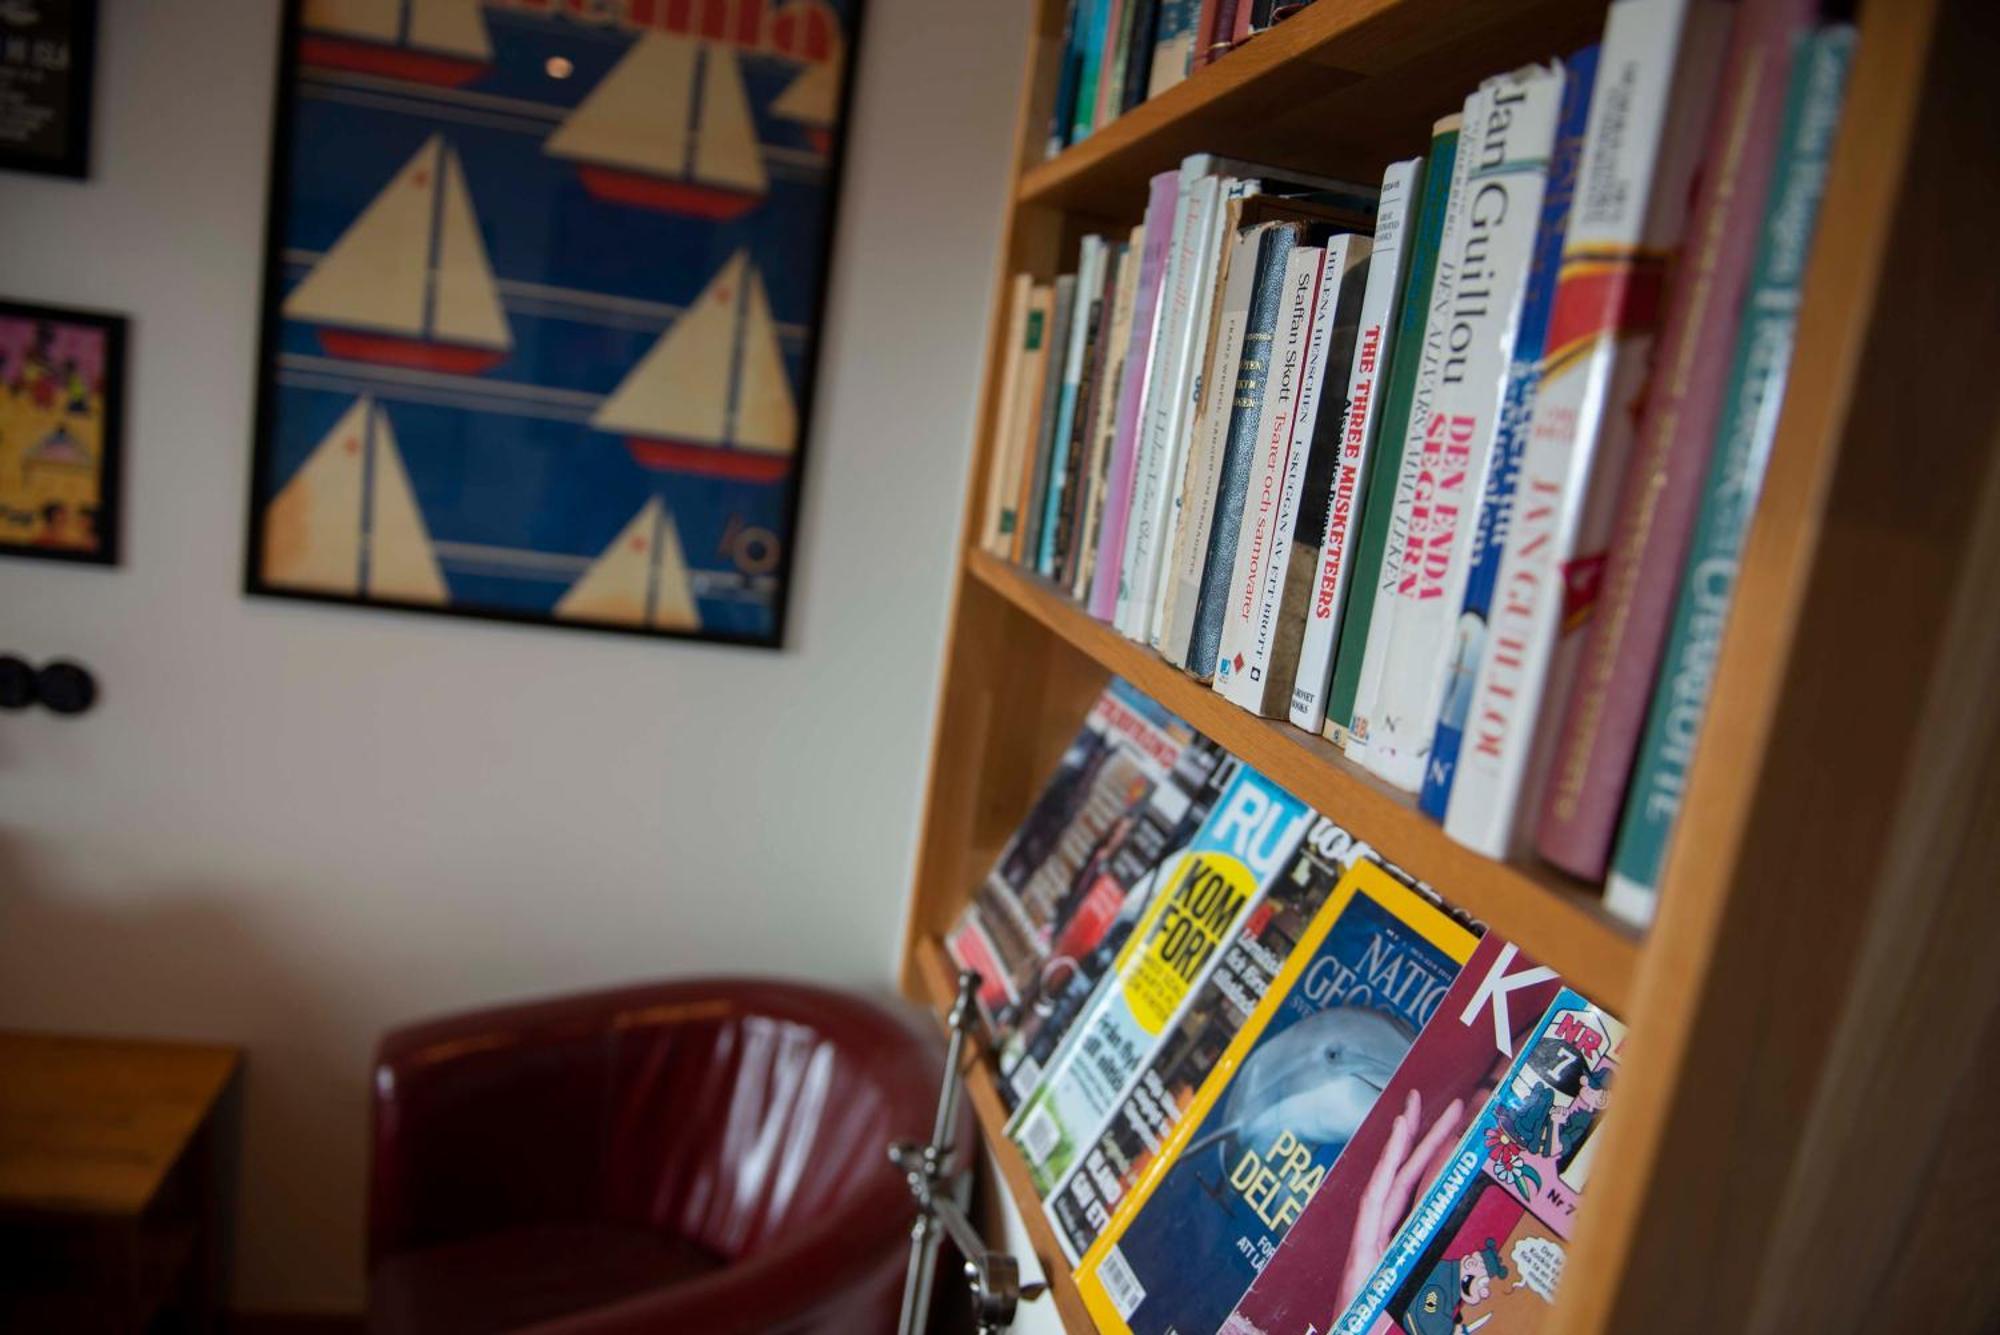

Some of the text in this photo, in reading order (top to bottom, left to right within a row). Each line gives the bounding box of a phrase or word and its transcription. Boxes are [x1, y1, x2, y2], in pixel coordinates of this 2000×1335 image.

[1480, 87, 1527, 171] Jan
[1317, 250, 1337, 321] HELENA
[1443, 181, 1509, 384] Guillou
[1299, 327, 1323, 424] HENSCHEN
[1241, 272, 1310, 624] Staffan Skott Tsarer och samovarer
[1316, 321, 1380, 620] THE THREE MUSKETEERS
[1275, 447, 1301, 535] SKUGGAN
[1397, 411, 1447, 599] SEGERN
[1417, 415, 1476, 600] DEN ENDA
[1267, 563, 1281, 596] ETT
[1382, 516, 1408, 597] LEKEN
[1255, 600, 1273, 663] BROTT
[1174, 857, 1249, 940] KOM
[1547, 1046, 1577, 1081] 7
[1554, 1012, 1603, 1060] NR
[1228, 1148, 1303, 1232] DELF
[1265, 1128, 1326, 1210] PRA
[1401, 1151, 1480, 1257] HEMMAVID
[1547, 1187, 1577, 1217] Nr 7
[1235, 1235, 1257, 1261] ATT
